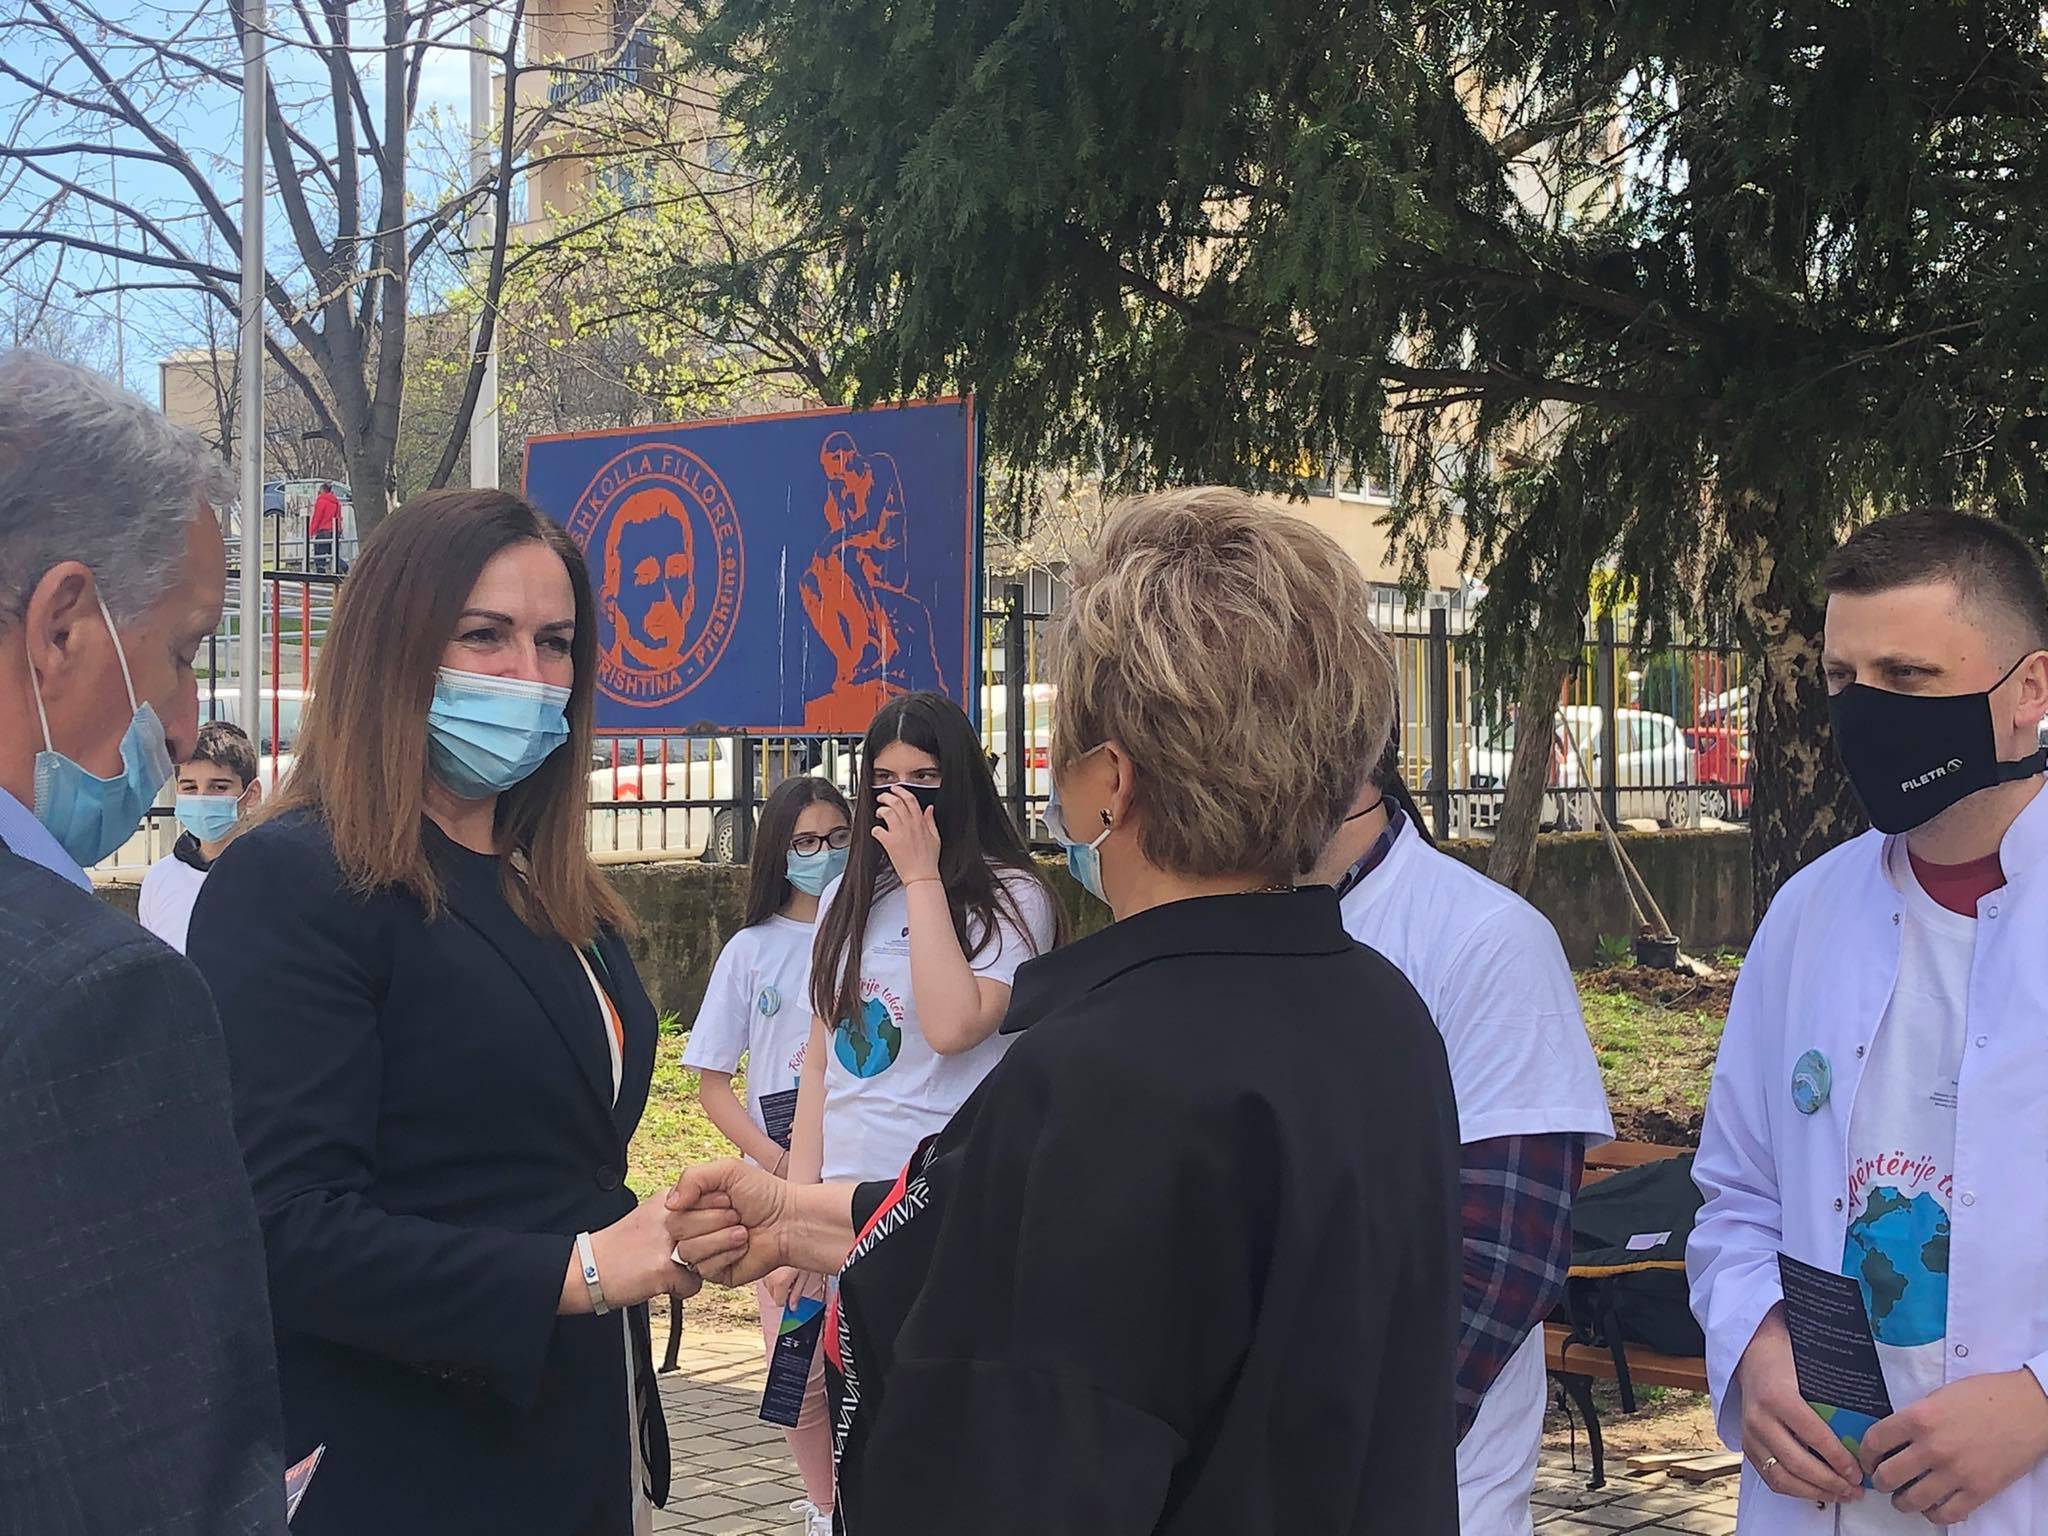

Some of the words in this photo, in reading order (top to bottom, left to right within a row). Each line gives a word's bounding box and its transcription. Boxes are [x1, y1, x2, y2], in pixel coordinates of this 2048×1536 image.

[571, 454, 653, 547] SHKOLLA
[661, 453, 734, 541] FILLORE
[598, 659, 682, 696] RISHTINA
[1848, 1150, 1937, 1208] përtërije
